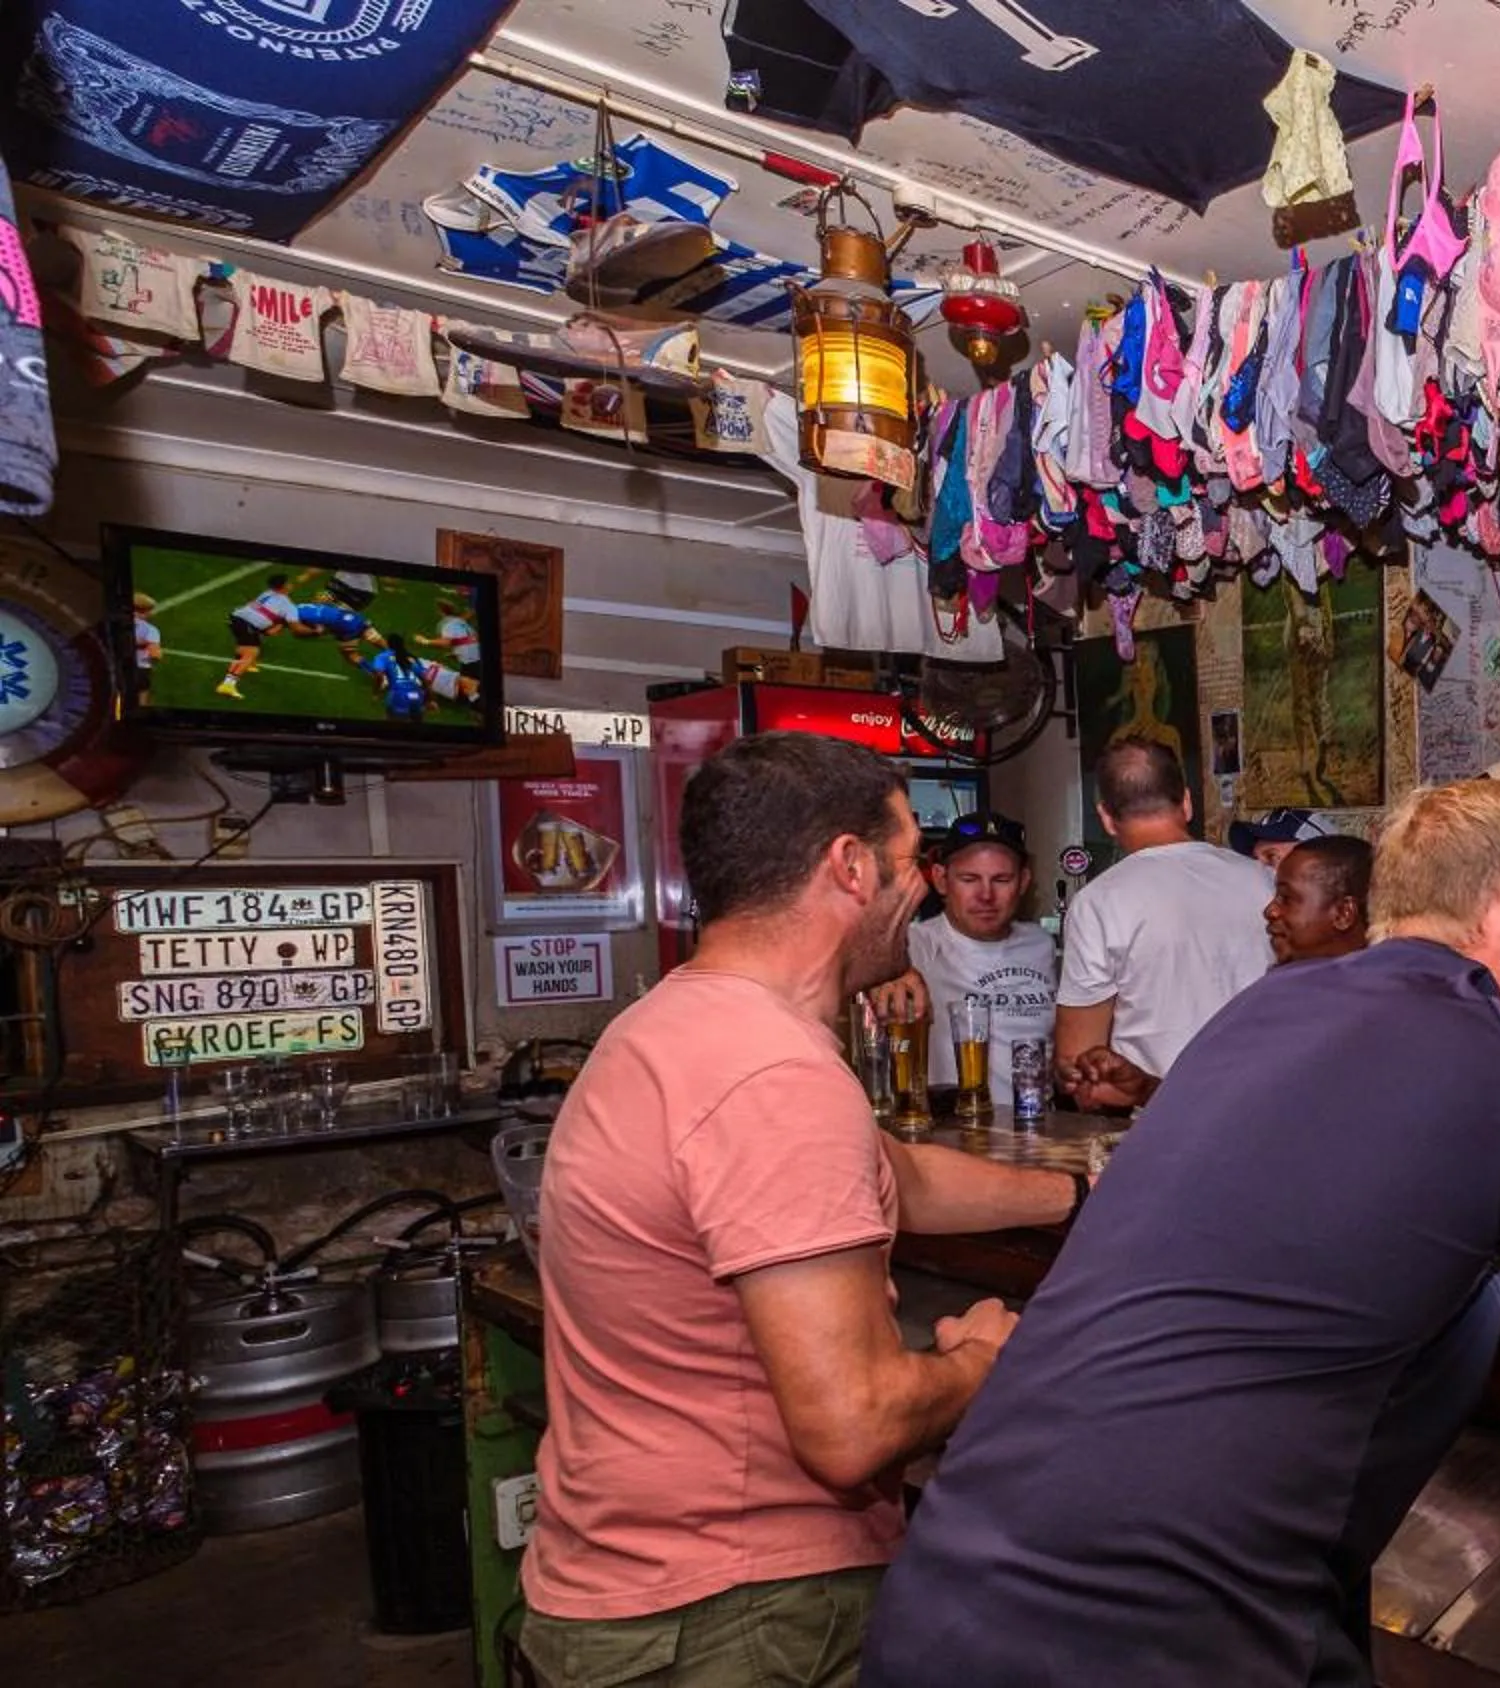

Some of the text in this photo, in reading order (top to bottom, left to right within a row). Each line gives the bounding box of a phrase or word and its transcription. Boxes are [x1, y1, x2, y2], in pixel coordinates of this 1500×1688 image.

[613, 717, 644, 743] WP
[851, 711, 893, 728] enjoy
[126, 891, 365, 927] MWF 184 GP
[145, 933, 350, 969] TETTY WP
[530, 938, 577, 957] STOP
[514, 959, 593, 977] WASH YOUR
[130, 974, 368, 1015] SNG 890 GP
[532, 977, 579, 994] HANDS
[386, 999, 421, 1030] GP
[317, 1014, 358, 1044] FS
